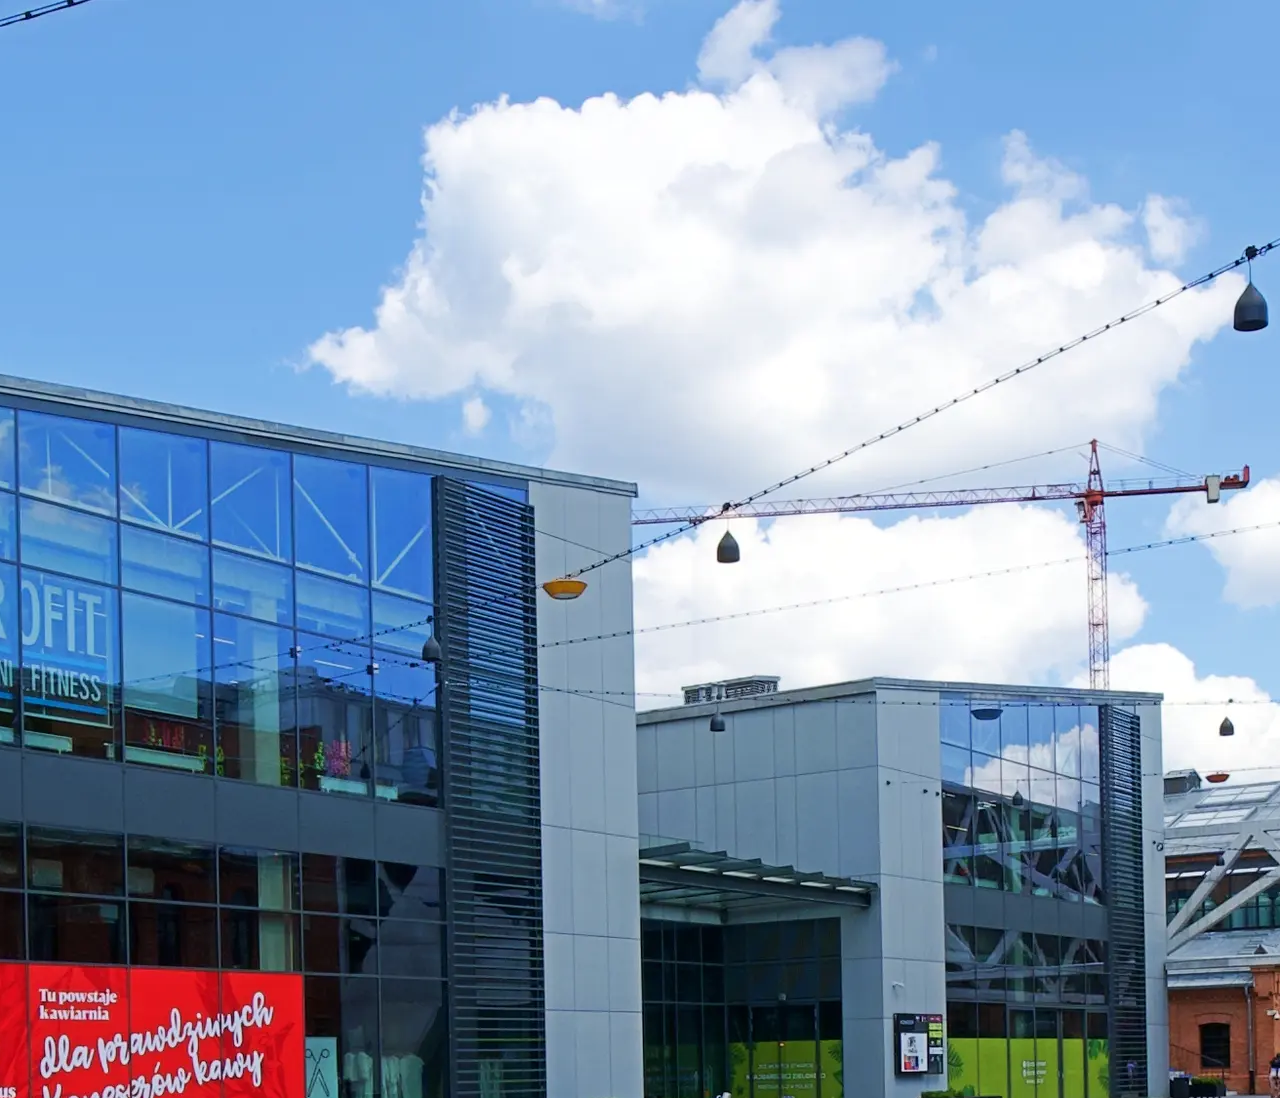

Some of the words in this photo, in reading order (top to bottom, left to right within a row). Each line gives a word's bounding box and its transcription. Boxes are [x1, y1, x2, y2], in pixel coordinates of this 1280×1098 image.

[31, 664, 102, 702] FITNESS
[39, 988, 56, 1002] Tu
[58, 988, 117, 1004] powstaje
[39, 1005, 109, 1021] kawiarnia
[40, 1034, 94, 1079] dla
[97, 991, 274, 1074] prawdziwych
[190, 1050, 264, 1088] kawy
